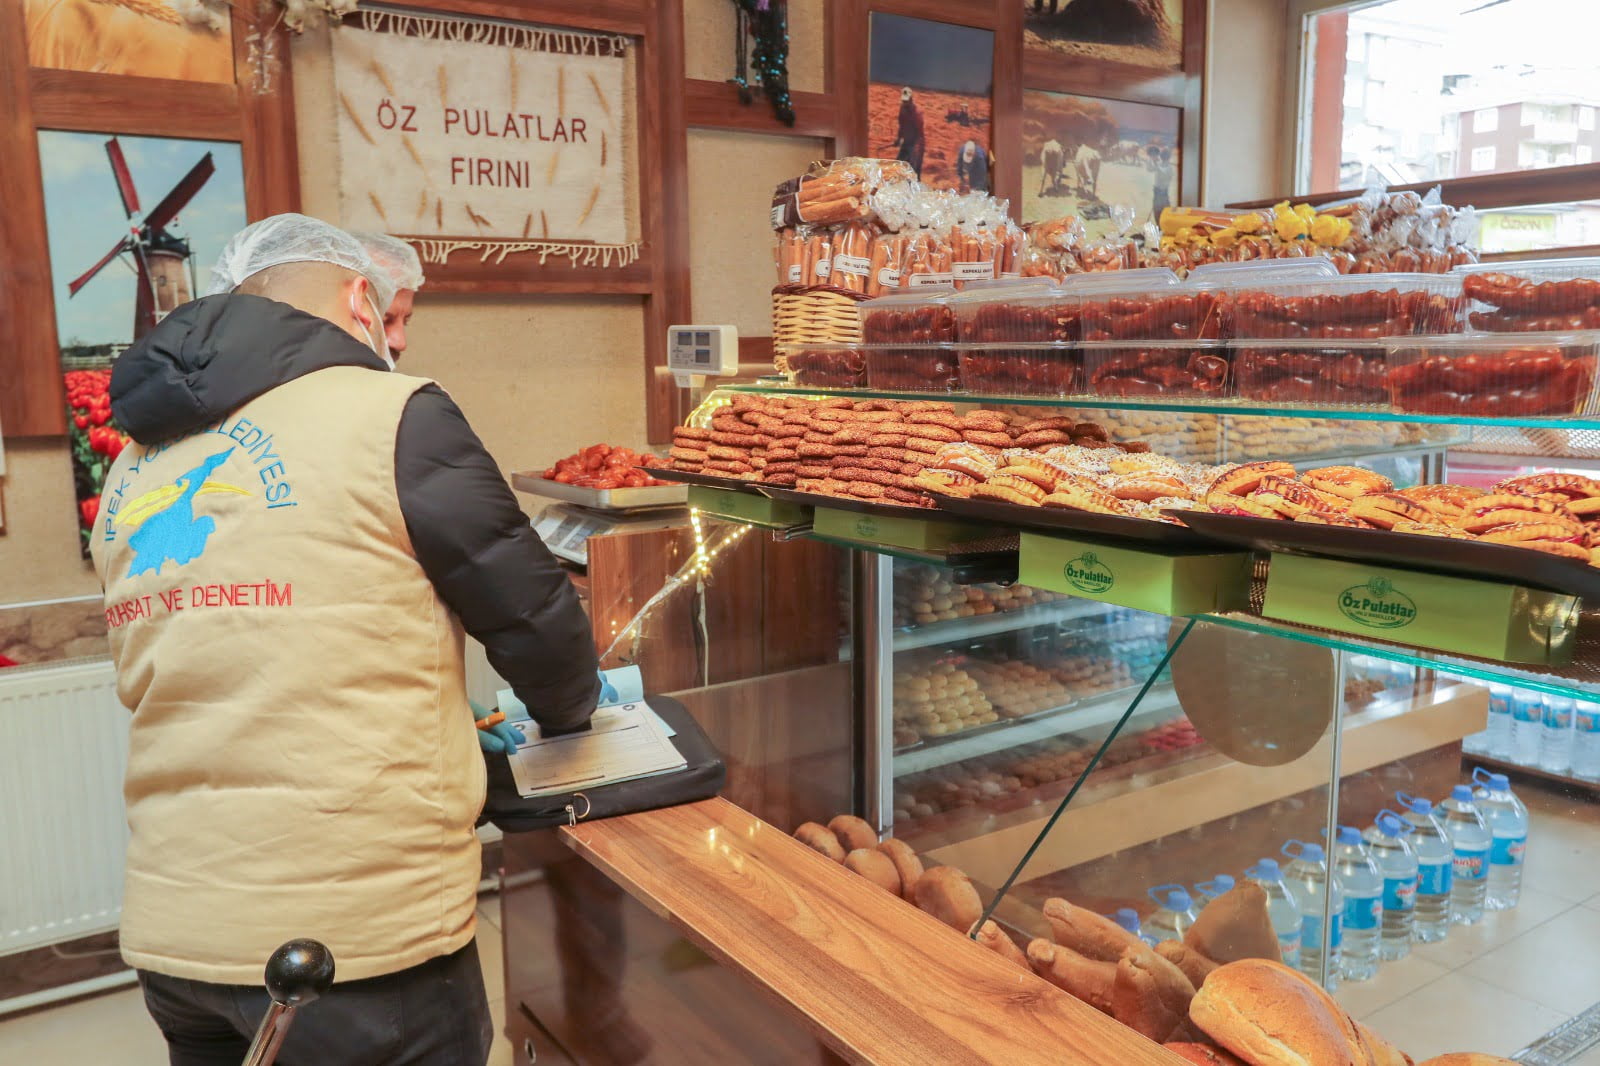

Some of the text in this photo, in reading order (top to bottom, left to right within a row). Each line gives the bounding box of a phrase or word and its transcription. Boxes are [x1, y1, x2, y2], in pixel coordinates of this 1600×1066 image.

[377, 99, 587, 143] ÖZ PULATLAR
[451, 157, 530, 188] FIRINI
[1066, 564, 1079, 578] Öz
[1079, 569, 1112, 584] Pulatlar
[105, 579, 292, 630] RUHSAT VE DENETİM
[1342, 592, 1361, 609] Öz
[1362, 598, 1414, 617] Pulatlar
